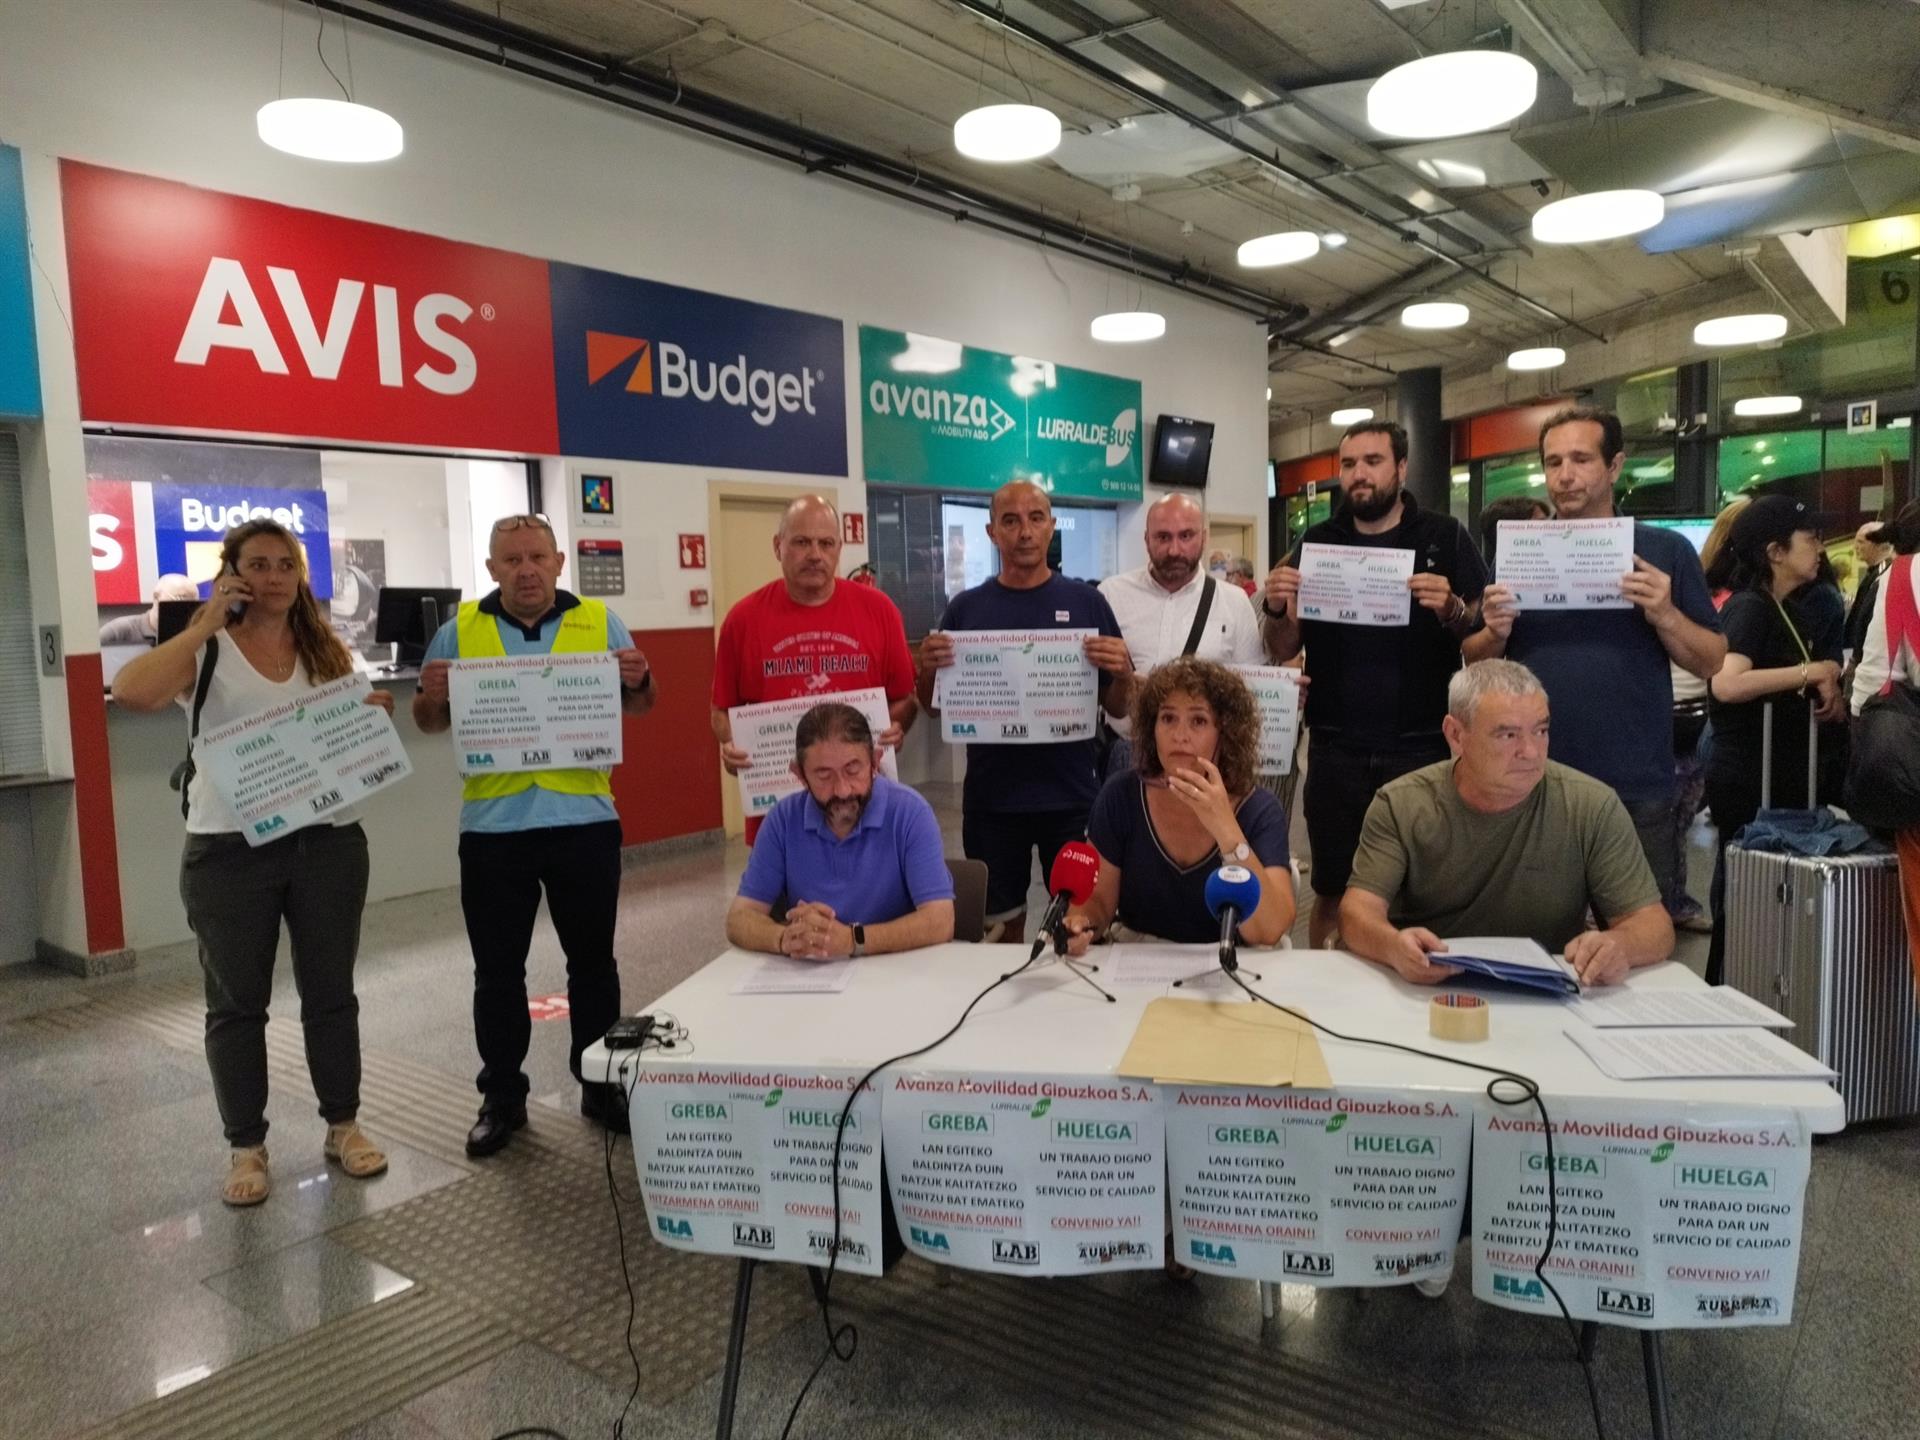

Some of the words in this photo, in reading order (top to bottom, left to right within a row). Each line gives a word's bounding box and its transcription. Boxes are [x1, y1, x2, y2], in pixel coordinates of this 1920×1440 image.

[1881, 270, 1910, 305] 6
[174, 256, 477, 395] AVIS
[658, 340, 816, 428] Budget
[869, 380, 988, 427] avanza
[1037, 417, 1135, 447] LURRALDEBUS
[45, 631, 56, 665] 3
[456, 661, 494, 672] Avanza
[495, 658, 545, 669] Movilidad
[764, 656, 813, 677] MIAMI
[820, 653, 869, 673] BEACH
[965, 654, 999, 663] GREBA
[1038, 655, 1080, 663] HUELGA
[479, 679, 516, 690] GREBA
[557, 676, 601, 688] HUELGA
[313, 700, 360, 725] HUELGA
[759, 724, 793, 736] GREBA
[952, 724, 976, 733] ELA
[1002, 725, 1028, 734] LAB
[235, 733, 276, 757] GREBA
[466, 753, 494, 764] ELA
[523, 752, 549, 763] LAB
[639, 1071, 694, 1084] Avanza
[698, 1071, 770, 1087] Movilidad
[895, 1077, 954, 1092] Avanza
[957, 1079, 1037, 1096] Movilidad
[1121, 1086, 1153, 1102] S.A.
[672, 1103, 727, 1119] GREBA
[1178, 1092, 1242, 1107] Avanza
[1246, 1094, 1332, 1112] Movilidad
[1424, 1102, 1459, 1118] S.A.
[928, 1113, 988, 1132] GREBA
[1057, 1121, 1132, 1140] HUELGA
[666, 1132, 686, 1141] LAN
[690, 1132, 732, 1143] EGITEKO
[1215, 1128, 1279, 1144] GREBA
[1563, 1120, 1659, 1140] Movilidad
[1758, 1130, 1796, 1147] S.A.
[773, 1139, 789, 1148] UN
[841, 1141, 872, 1155] DIGNO
[922, 1144, 943, 1155] LAN
[947, 1146, 992, 1157] EGITEKO
[1354, 1136, 1434, 1154] HUELGA
[657, 1148, 714, 1158] BALDINTZA
[717, 1149, 742, 1159] DUIN
[1040, 1153, 1056, 1163] UN
[1060, 1153, 1111, 1164] TRABAJO
[1114, 1153, 1151, 1164] DIGNO
[648, 1163, 685, 1174] BATZUK
[688, 1165, 754, 1176] KALITATEZKO
[790, 1156, 817, 1166] PARA
[844, 1159, 858, 1170] UN
[913, 1159, 972, 1173] BALDINTZA
[975, 1163, 1003, 1174] DUIN
[1208, 1156, 1232, 1166] LAN
[1235, 1157, 1284, 1168] EGITEKO
[771, 1171, 816, 1183] SERVICIO
[820, 1175, 833, 1184] DE
[1057, 1171, 1087, 1180] PARA
[1091, 1171, 1114, 1180] DAR
[1118, 1170, 1135, 1180] UN
[1198, 1171, 1262, 1184] BALDINTZA
[1266, 1175, 1296, 1186] DUIN
[1335, 1166, 1353, 1176] UN
[1357, 1166, 1411, 1178] TRABAJO
[1414, 1168, 1455, 1178] DIGNO
[1682, 1168, 1769, 1188] HUELGA
[645, 1177, 687, 1190] ZERBITZU
[690, 1180, 709, 1190] BAT
[713, 1181, 760, 1193] EMATEKO
[902, 1175, 942, 1187] BATZUK
[945, 1179, 1017, 1192] KALITATEZKO
[1036, 1185, 1086, 1196] SERVICIO
[1090, 1187, 1104, 1196] DE
[1108, 1186, 1155, 1196] CALIDAD
[1354, 1183, 1386, 1194] PARA
[1390, 1184, 1414, 1195] DAR
[1418, 1185, 1436, 1195] UN
[898, 1189, 944, 1204] ZERBITZU
[947, 1194, 967, 1206] BAT
[971, 1196, 1024, 1210] EMATEKO
[1186, 1186, 1230, 1198] BATZUK
[1233, 1190, 1310, 1204] KALITATEZKO
[1520, 1184, 1544, 1195] LAN
[1551, 1186, 1603, 1200] GITEKO
[648, 1192, 715, 1209] HITZARMENA
[718, 1198, 759, 1212] ORAIN!!
[1330, 1199, 1385, 1210] SERVICIO
[1388, 1201, 1404, 1211] DE
[1407, 1199, 1457, 1211] CALIDAD
[1659, 1198, 1679, 1209] UN
[1683, 1200, 1742, 1213] TRABAJO
[1746, 1202, 1790, 1215] DIGNO
[842, 1209, 861, 1224] YA!!
[902, 1204, 973, 1224] HITZARMENA
[976, 1215, 1022, 1228] ORAIN!!
[1180, 1200, 1231, 1216] ZERBITZU
[1235, 1206, 1256, 1218] BAT
[1260, 1208, 1318, 1222] EMATEKO
[1581, 1207, 1615, 1218] DUIN
[657, 1215, 693, 1236] ELA
[735, 1225, 772, 1244] LAB
[1051, 1217, 1113, 1228] CONVENIO
[1117, 1216, 1141, 1228] YA!!
[1183, 1216, 1262, 1236] HITZARMENA
[1266, 1226, 1316, 1240] ORAIN!!
[1491, 1217, 1540, 1229] BATZUK
[1679, 1217, 1714, 1229] PARA
[1718, 1219, 1745, 1230] DAR
[1750, 1220, 1769, 1232] UN
[910, 1226, 950, 1249] ELA
[995, 1242, 1037, 1259] LAB
[1346, 1228, 1412, 1242] CONVENIO
[1416, 1228, 1440, 1240] YA!!
[1653, 1233, 1711, 1247] SERVICIO
[1715, 1236, 1732, 1247] DE
[1737, 1237, 1790, 1248] CALIDAD
[1482, 1233, 1542, 1247] ZERBITZU
[1549, 1238, 1571, 1250] AT
[1575, 1241, 1638, 1257] EMATEKO
[1191, 1240, 1236, 1262] ELA
[1286, 1253, 1332, 1272] LAB
[1579, 1259, 1635, 1276] ORAIN!!
[1667, 1266, 1740, 1281] CONVENIO
[1745, 1268, 1770, 1281] YA!!
[1493, 1273, 1545, 1297] ELA
[1601, 1290, 1651, 1312] LAB
